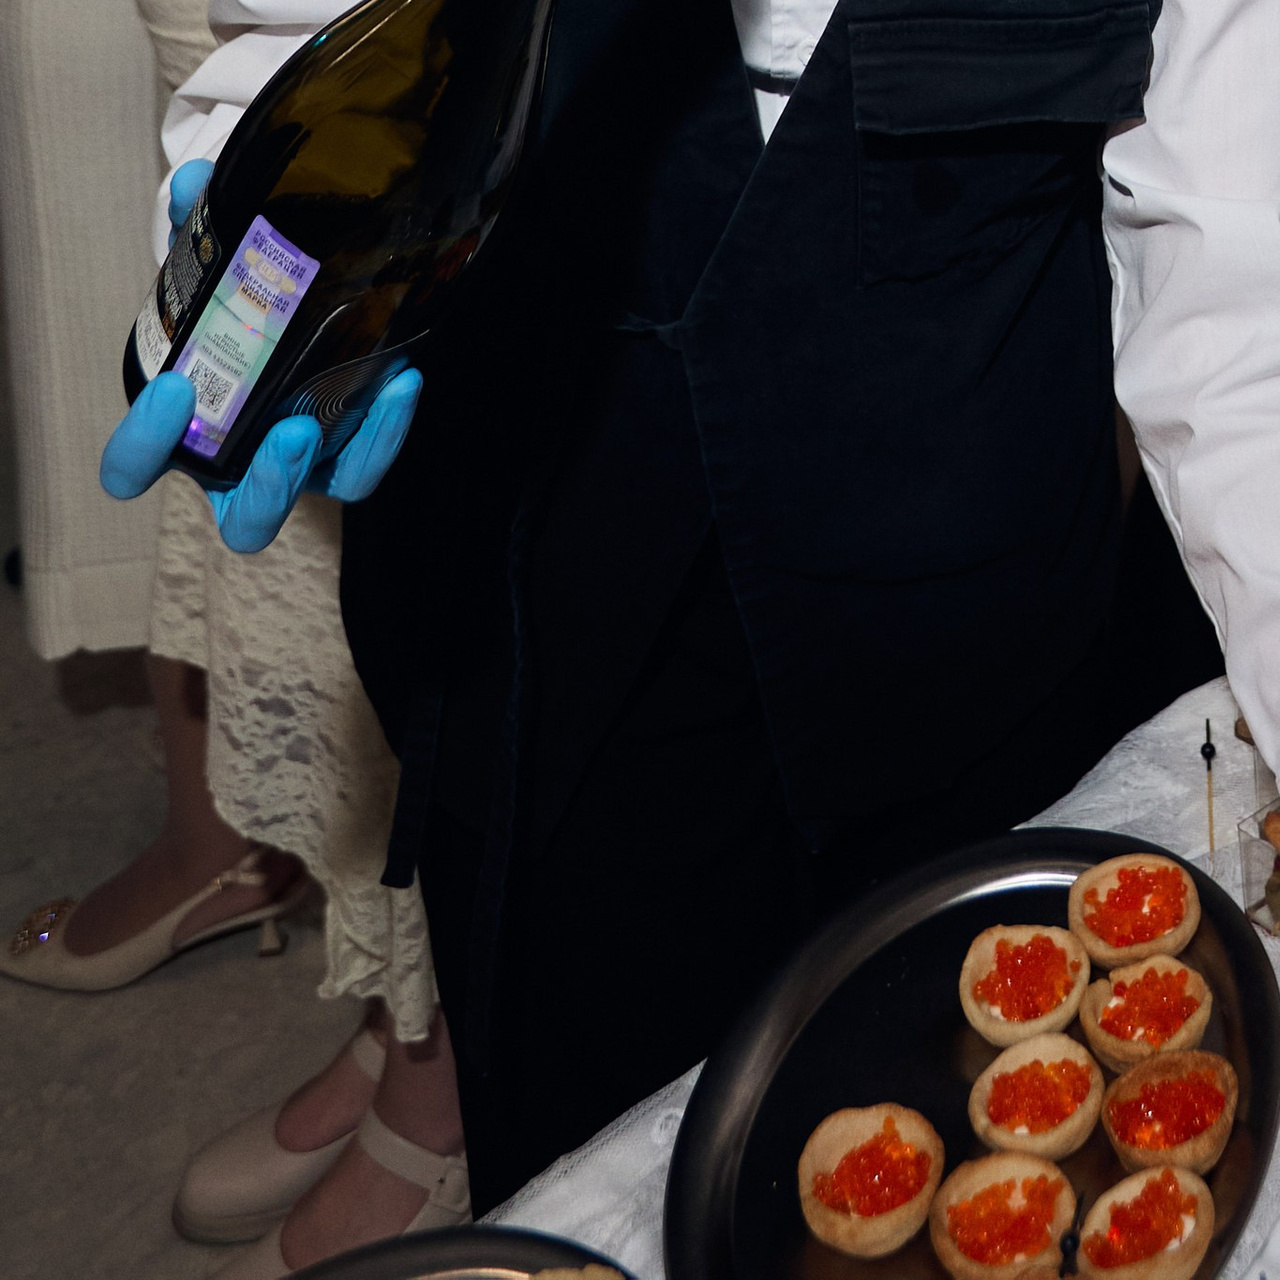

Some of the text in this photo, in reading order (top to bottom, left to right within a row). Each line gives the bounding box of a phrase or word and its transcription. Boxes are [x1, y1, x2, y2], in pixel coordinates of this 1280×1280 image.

[252, 236, 304, 280] ФЕДЕРАЦИИ
[255, 229, 308, 273] РОССИЙСКАЯ
[232, 267, 287, 313] СПЕЦИАЛЬНАЯ
[236, 262, 291, 307] ФЕДЕРАЛЬНАЯ
[241, 286, 268, 310] МАРКА
